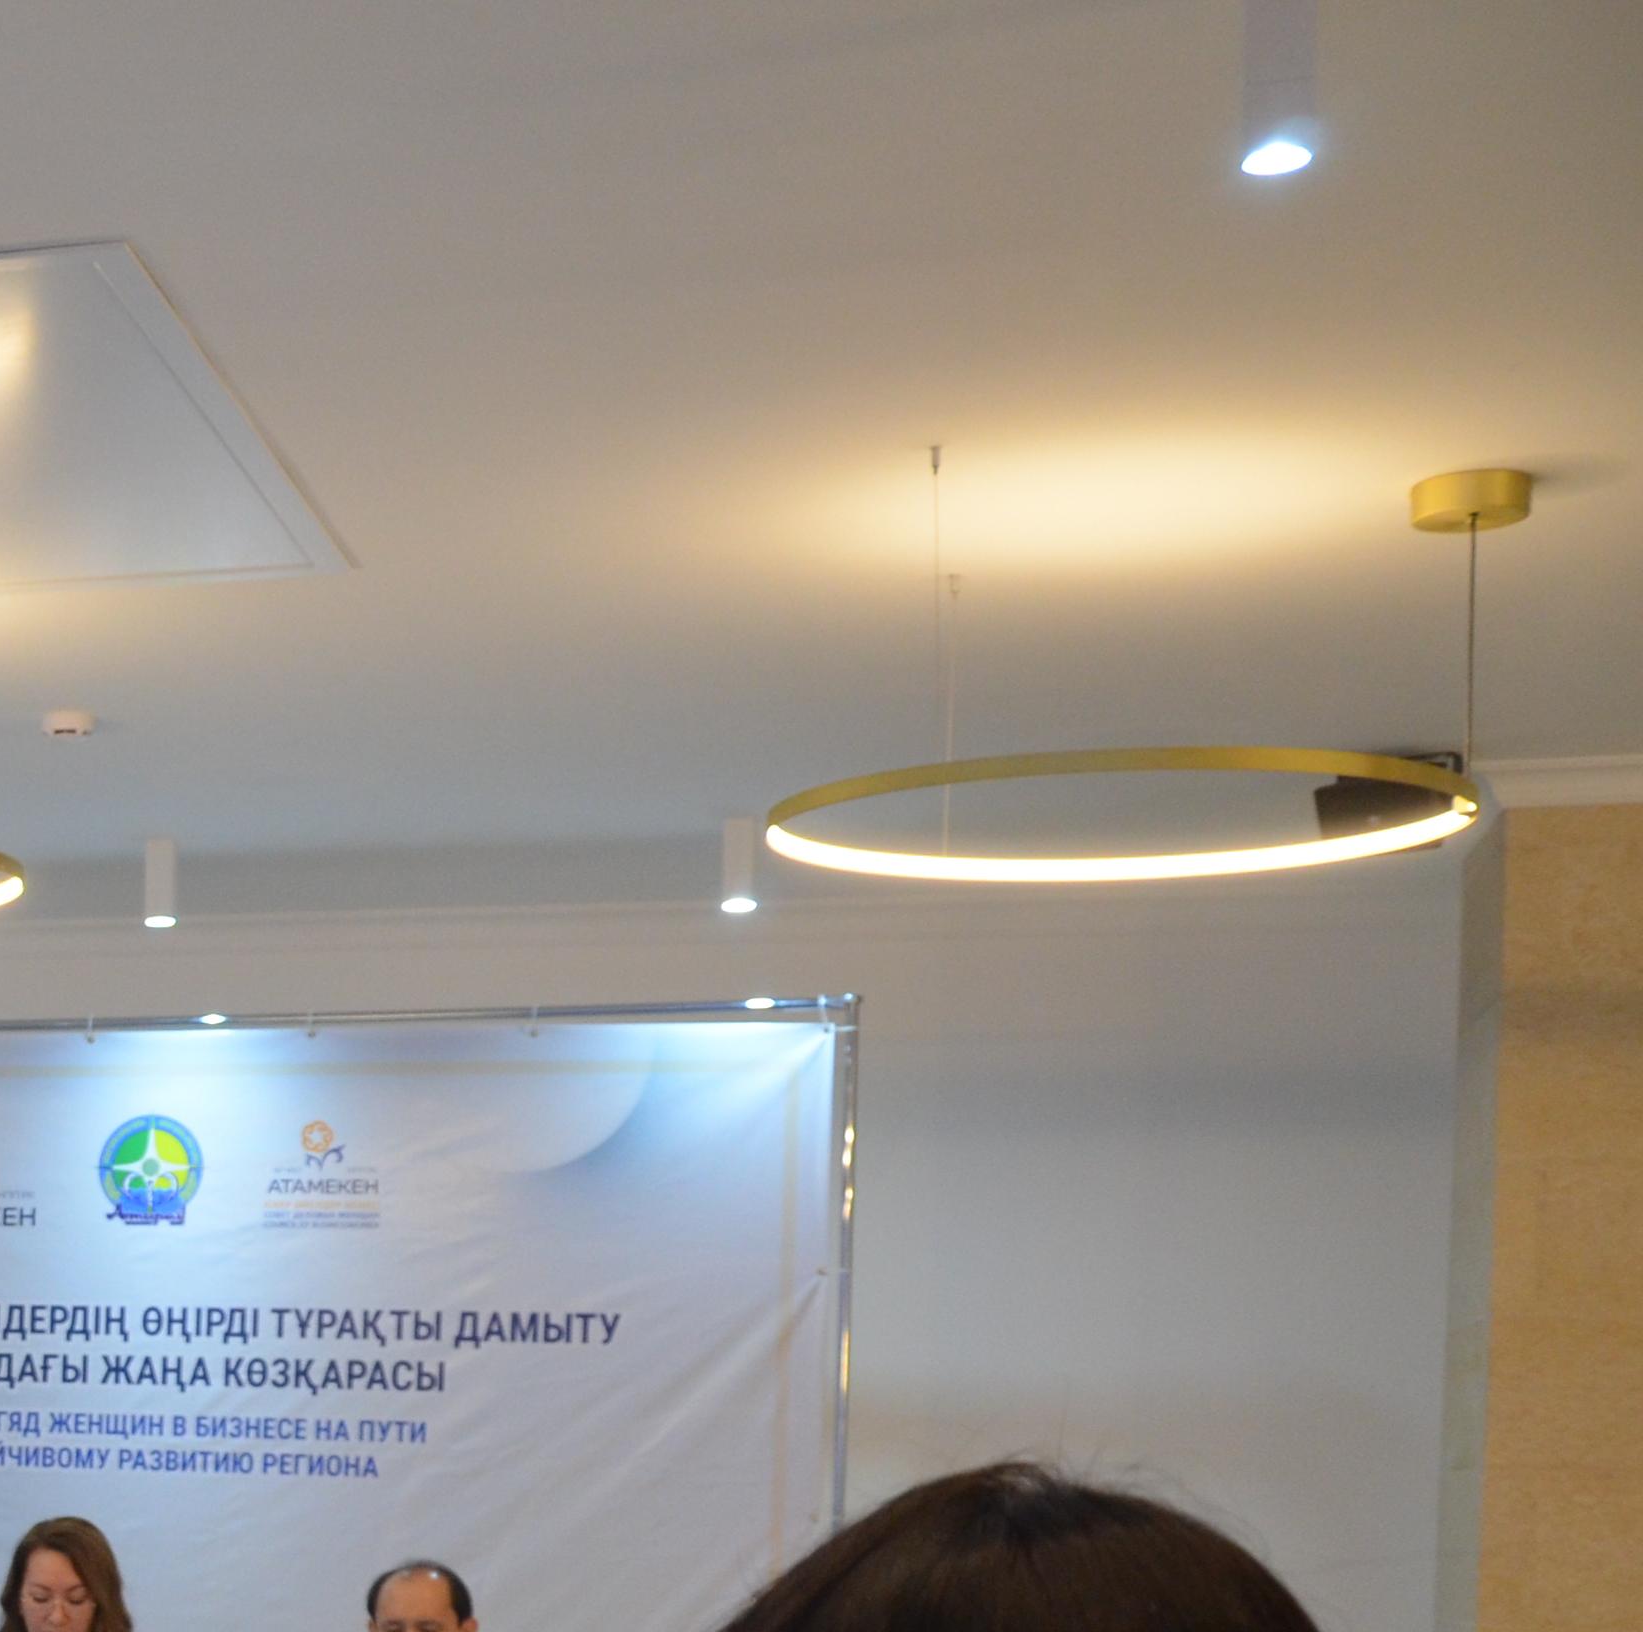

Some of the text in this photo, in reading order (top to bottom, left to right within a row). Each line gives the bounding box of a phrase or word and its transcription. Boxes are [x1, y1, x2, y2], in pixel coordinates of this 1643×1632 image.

[268, 1179, 379, 1195] АТАМЕКЕН
[142, 1306, 259, 1344] ӨҢІРДІ
[271, 1308, 442, 1346] ТҰРАҚТЫ
[454, 1311, 621, 1348] ДАМЫТУ
[101, 1355, 211, 1392] ЖАҢА
[224, 1357, 445, 1395] КӨЗҚАРАСЫ
[49, 1411, 164, 1439] ЖЕНЩИН
[173, 1415, 187, 1436] В
[195, 1416, 307, 1440] БИЗНЕСЕ
[315, 1419, 349, 1441] НА
[358, 1420, 428, 1443] ПУТИ
[118, 1448, 254, 1474] РАЗВИТИЮ
[263, 1453, 379, 1478] РЕГИОНА
